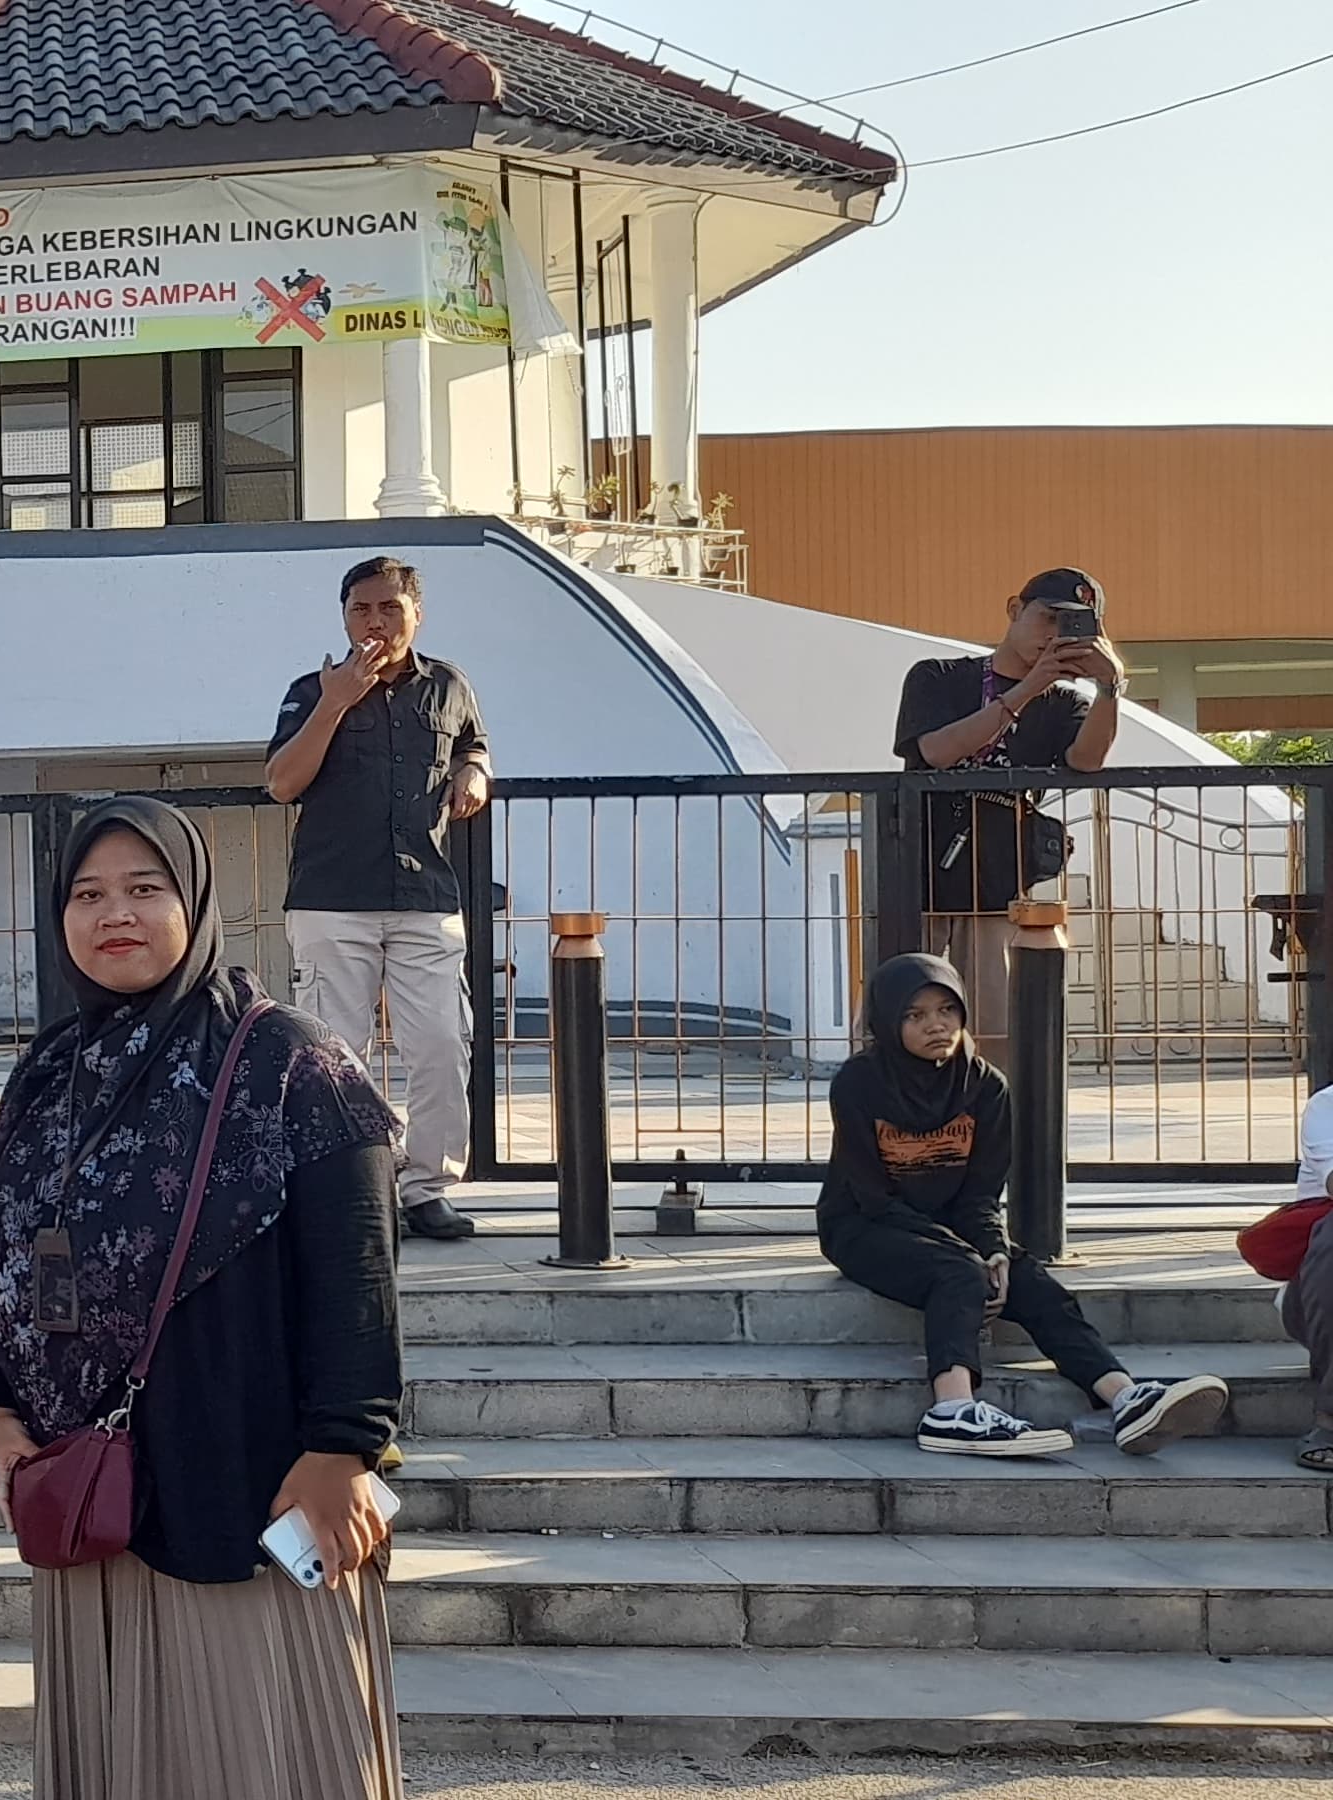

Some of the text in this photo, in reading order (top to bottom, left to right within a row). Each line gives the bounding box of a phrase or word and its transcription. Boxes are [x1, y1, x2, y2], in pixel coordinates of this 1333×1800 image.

[42, 222, 222, 253] KEBERSIHAN
[230, 210, 418, 242] LINGKUNGAN
[15, 288, 113, 314] BUANG
[121, 281, 236, 307] SAMPAH
[345, 310, 406, 333] DINAS
